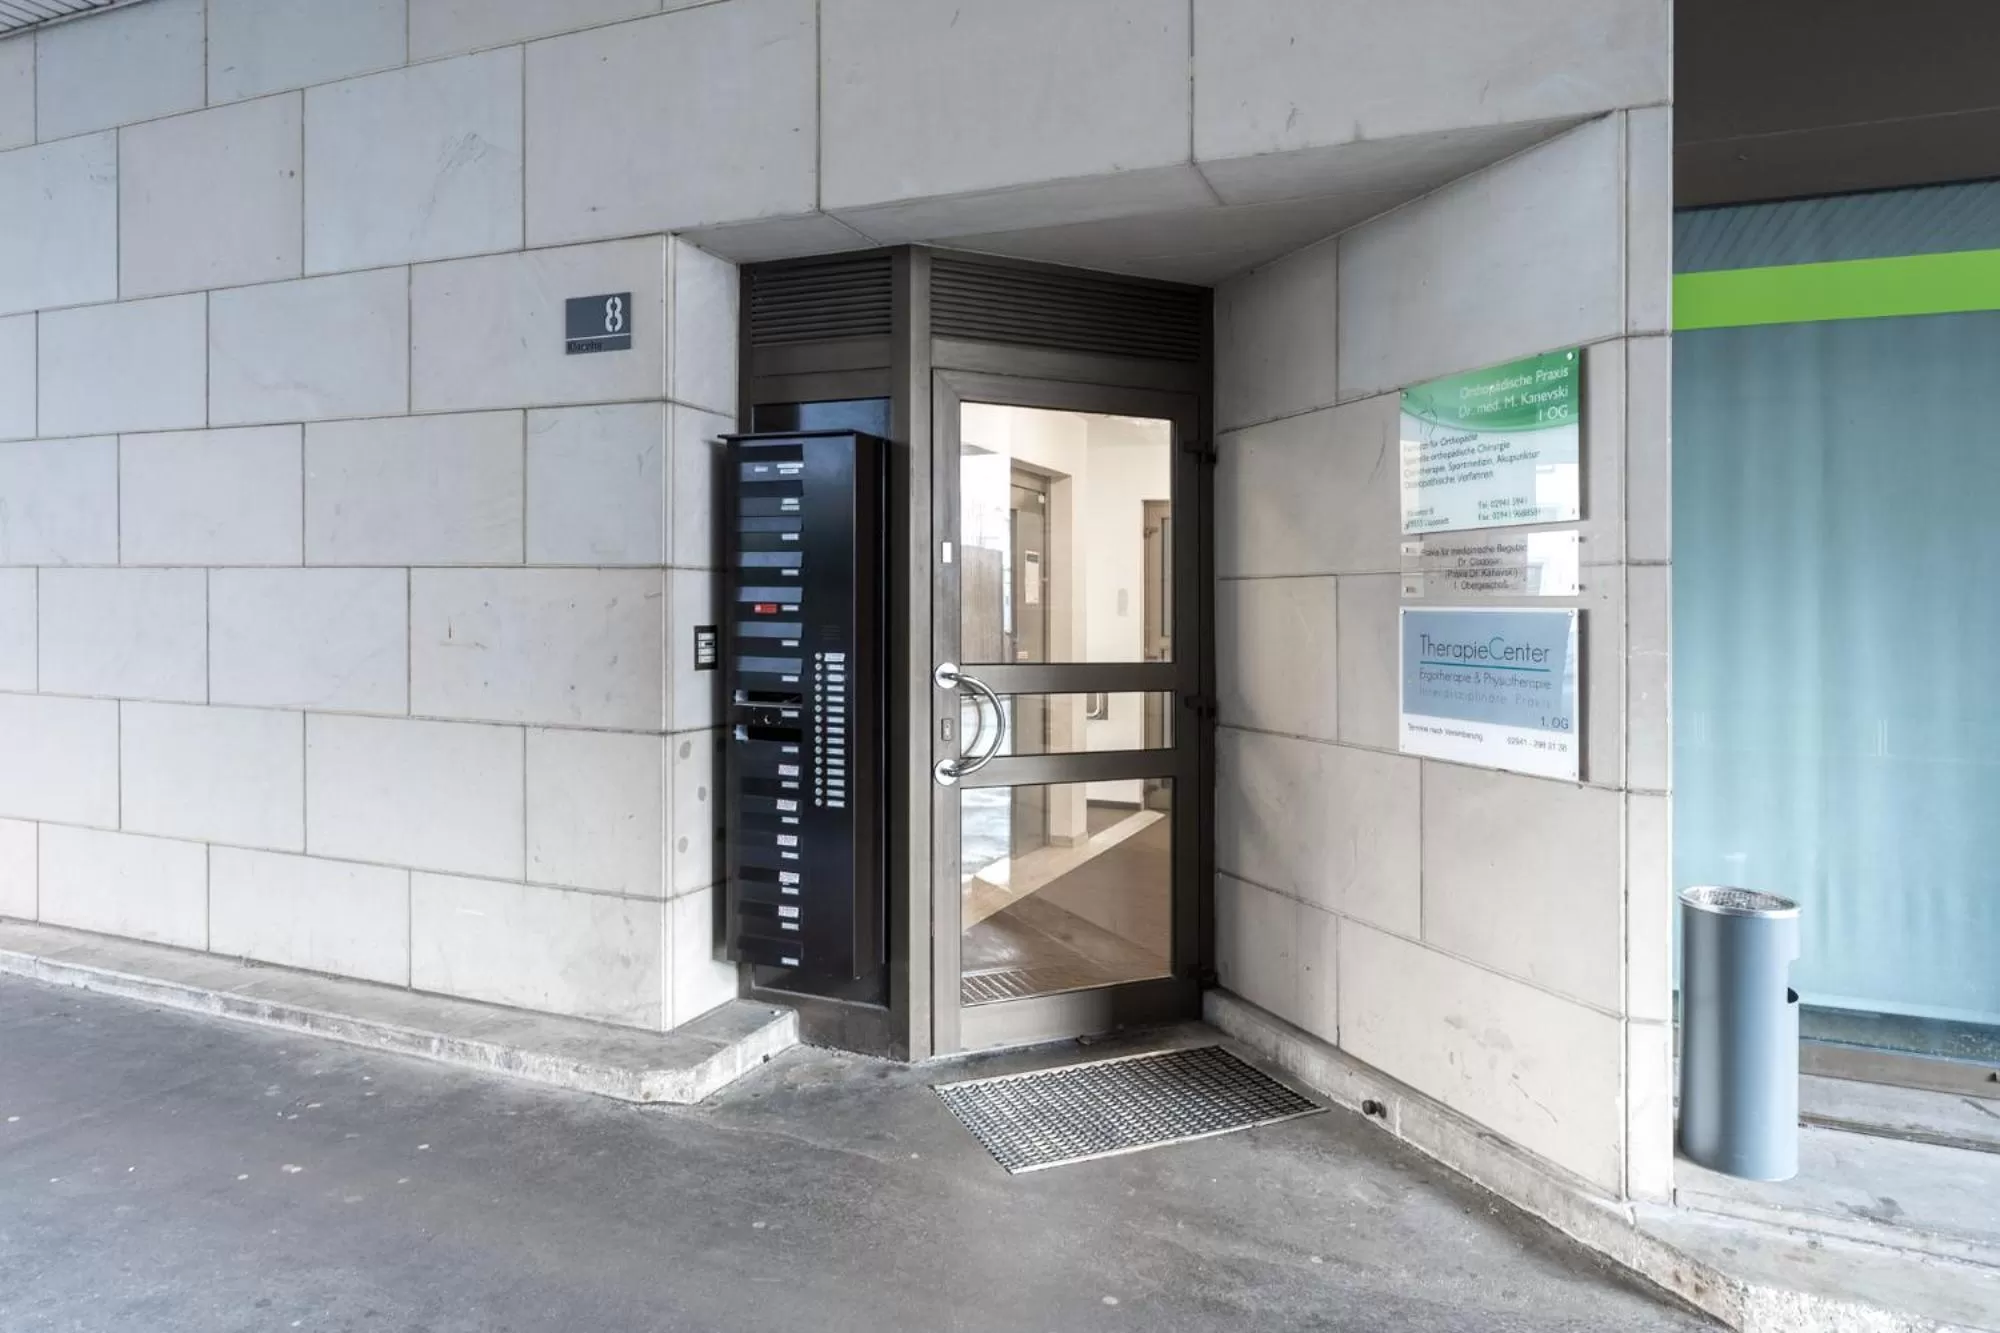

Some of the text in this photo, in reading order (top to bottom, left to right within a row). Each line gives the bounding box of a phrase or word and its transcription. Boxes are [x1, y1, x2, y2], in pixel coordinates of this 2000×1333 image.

[605, 296, 622, 332] 8
[1535, 365, 1569, 383] Praxis
[1521, 385, 1569, 405] Kanevski
[1420, 633, 1551, 663] TherapieCenter
[1420, 668, 1472, 684] Ergotherapie
